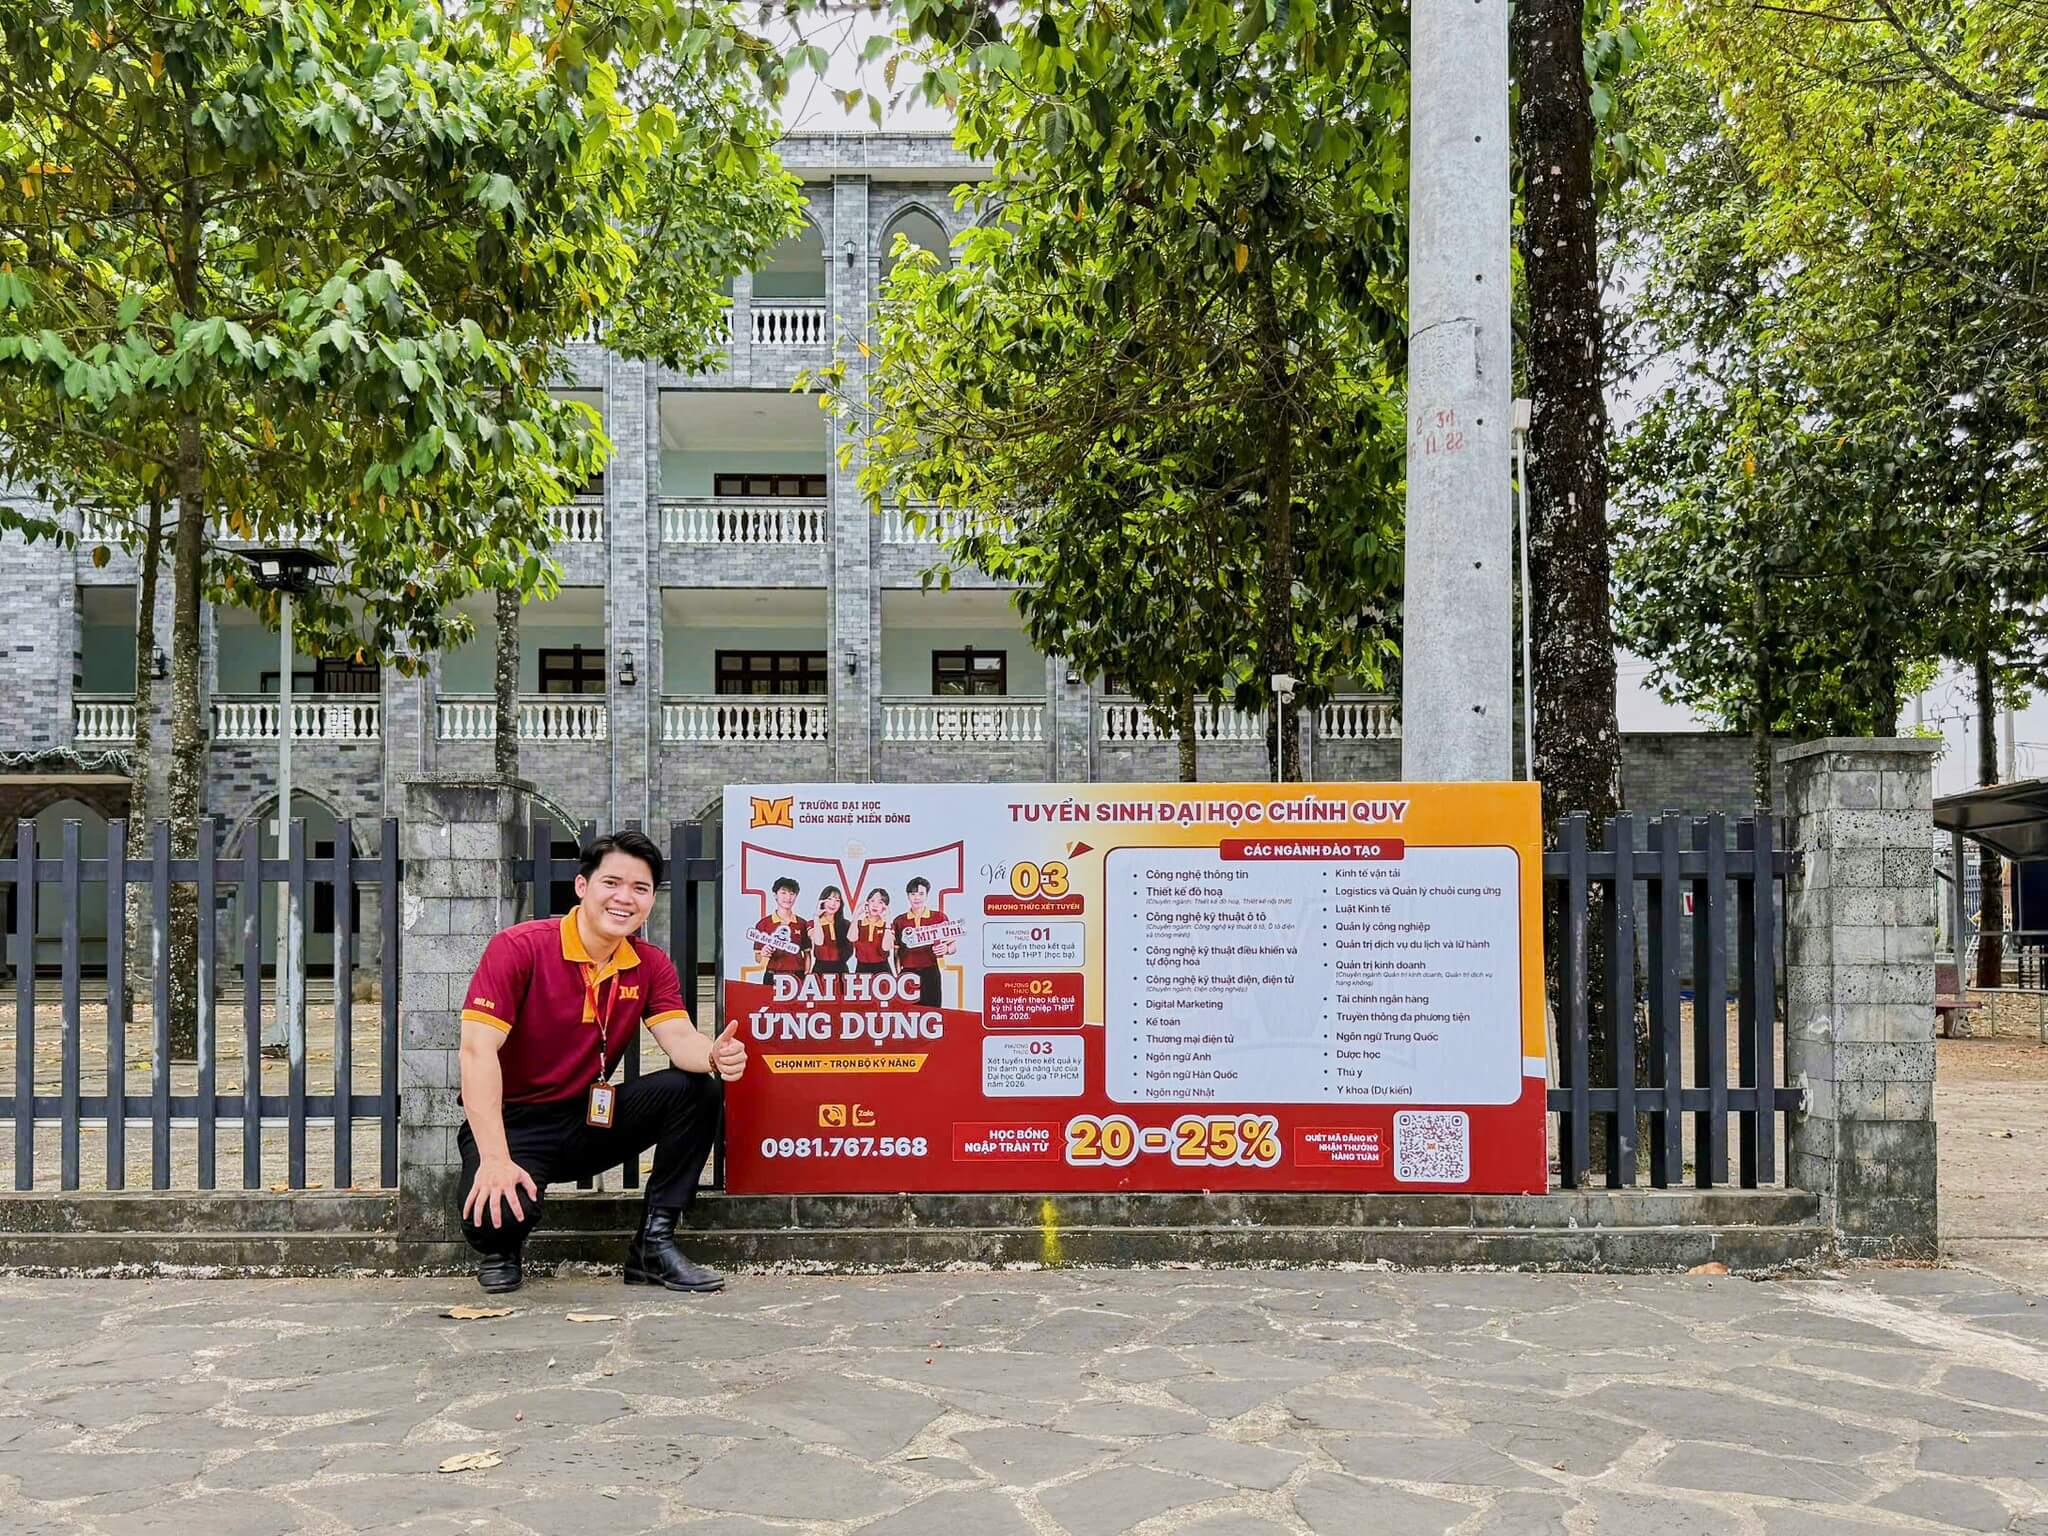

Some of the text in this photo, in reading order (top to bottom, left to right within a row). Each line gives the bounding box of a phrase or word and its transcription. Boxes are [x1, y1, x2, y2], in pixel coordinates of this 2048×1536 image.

[842, 801, 859, 812] ĐẠI
[862, 801, 881, 811] HỌC
[1008, 796, 1406, 826] TUYỂN SINH ĐẠI HỌC CHÍNH QUY
[750, 796, 794, 829] M
[799, 813, 824, 823] CÔNG
[885, 812, 911, 823] ĐÔNG
[1244, 842, 1381, 858] CÁC NGÀNH ĐÀO TẠO
[1010, 861, 1070, 897] 03
[1146, 869, 1249, 882] Công nghệ thông tin
[1335, 869, 1357, 877] Kinh
[1358, 868, 1368, 877] tế
[1370, 869, 1387, 879] vận
[1146, 886, 1172, 896] Thiết
[1174, 886, 1187, 896] kế
[1335, 887, 1377, 897] Logistics
[1392, 886, 1417, 895] Quản
[1419, 887, 1428, 897] lý
[1457, 888, 1481, 897] cung
[1483, 887, 1501, 897] ứng
[1336, 904, 1391, 914] Luật Kinh tế
[1146, 912, 1267, 923] Công nghệ kỹ thuật ô tô
[1336, 921, 1361, 931] Quản
[1372, 922, 1396, 932] công
[1398, 922, 1431, 932] nghiệp
[916, 929, 937, 942] MIT
[1031, 928, 1051, 940] 01
[1336, 939, 1361, 949] Quản
[1362, 940, 1373, 950] trị
[1374, 940, 1394, 950] dịch
[1410, 940, 1422, 948] du
[1424, 940, 1440, 950] lịch
[1442, 941, 1454, 949] và
[1466, 940, 1490, 948] hành
[1336, 960, 1426, 970] Quản trị kinh doanh
[1146, 975, 1171, 986] Công
[1172, 975, 1196, 986] nghệ
[1198, 975, 1209, 986] kỹ
[1211, 975, 1236, 985] thuật
[1262, 975, 1283, 985] điện
[618, 985, 639, 1000] M
[773, 974, 921, 1008] ĐẠI HỌC
[1029, 980, 1053, 994] 02
[1146, 1000, 1223, 1010] Digital Marketing
[1146, 1017, 1181, 1026] Kế toán
[1337, 1012, 1470, 1023] Truyền thông đa phương tiện
[749, 1006, 944, 1046] ỨNG DỤNG
[1146, 1034, 1182, 1045] Thương
[1183, 1034, 1200, 1044] mại
[1202, 1034, 1223, 1044] điện
[1336, 1032, 1362, 1043] Ngôn
[1384, 1032, 1411, 1043] Trung
[1413, 1032, 1438, 1041] Quốc
[1029, 1041, 1053, 1054] 03
[1146, 1052, 1171, 1063] Ngôn
[1192, 1052, 1211, 1061] Anh
[1336, 1050, 1381, 1060] Dược học
[774, 1060, 802, 1070] CHỌN
[804, 1060, 822, 1068] MIT
[829, 1060, 856, 1069] TRỌN
[1146, 1070, 1171, 1081] Ngôn
[1192, 1070, 1211, 1079] Hàn
[1213, 1070, 1238, 1079] Quốc
[1337, 1068, 1363, 1079] Thú y
[1146, 1088, 1171, 1099] Ngôn
[1192, 1088, 1215, 1097] Nhật
[1337, 1086, 1344, 1094] Y
[1346, 1086, 1369, 1094] khoa
[1389, 1086, 1412, 1096] kiến)
[858, 1109, 874, 1117] Zalo
[989, 1128, 1049, 1142] HỌC BỔNG
[761, 1137, 927, 1158] 0981.767.568
[965, 1140, 1049, 1154] NGẬP TRÀN TỪ
